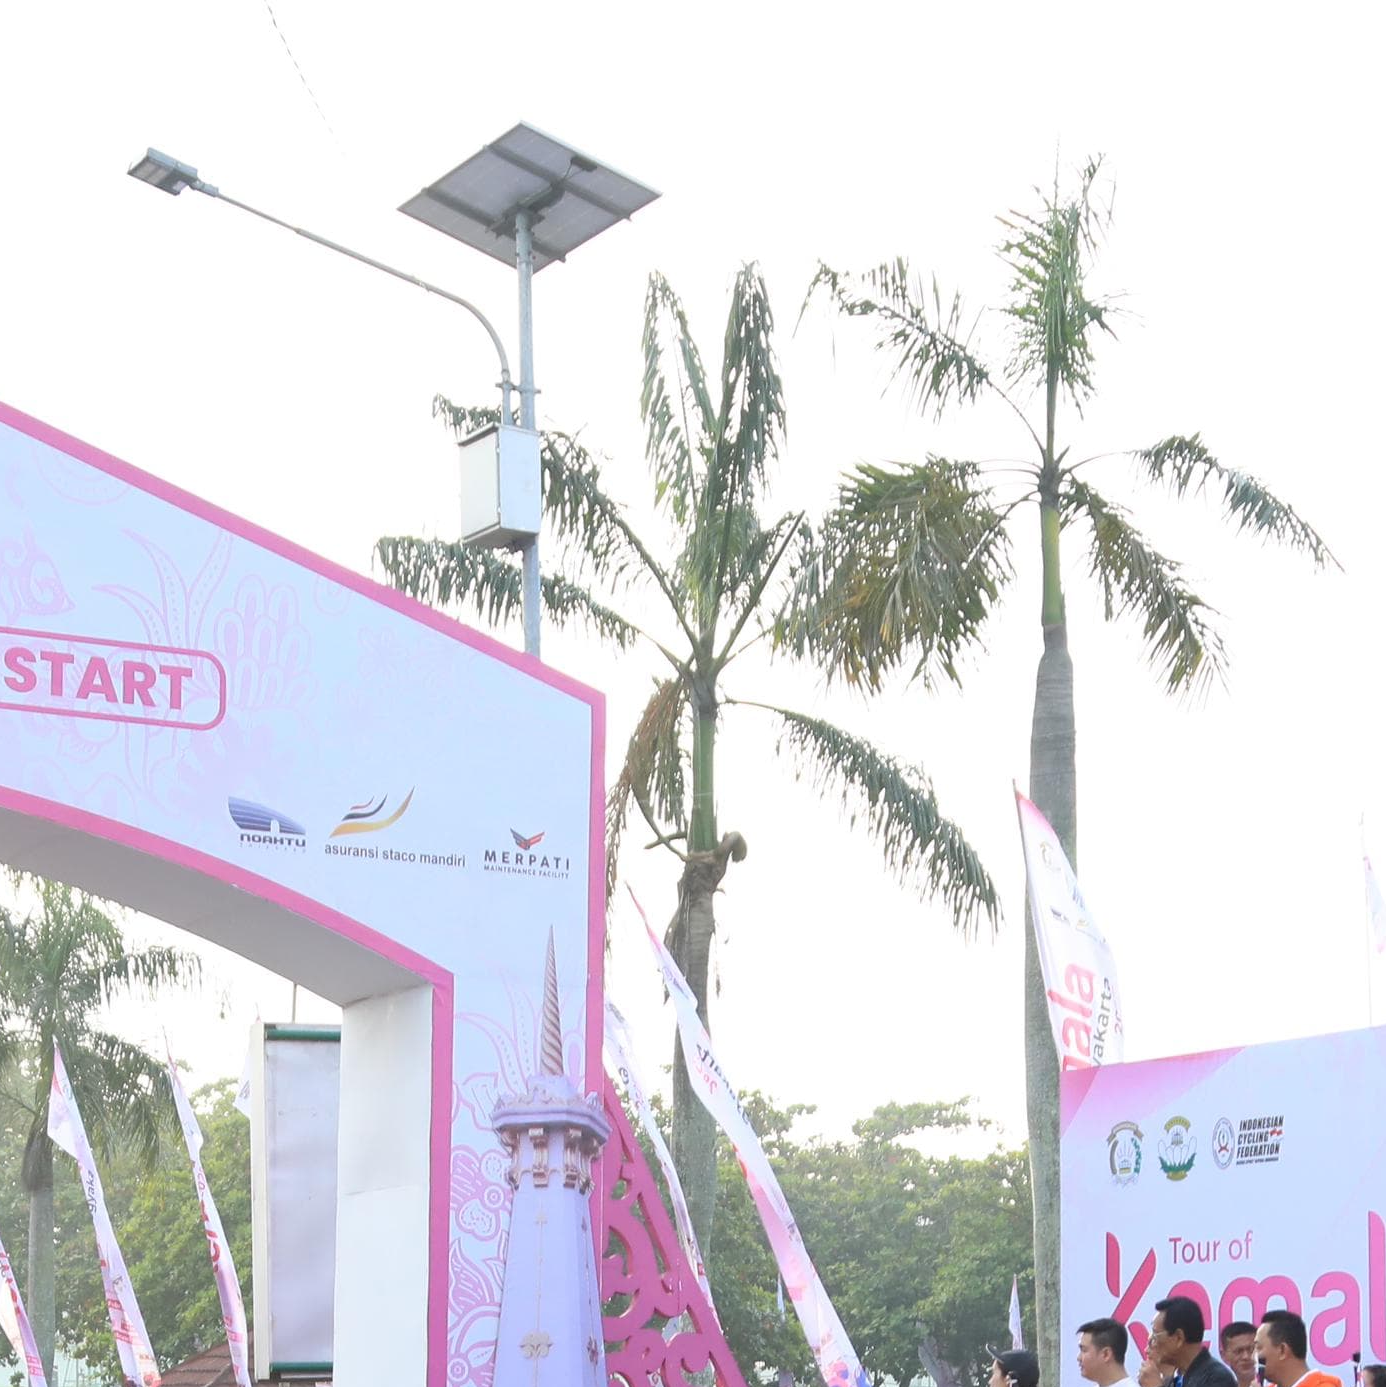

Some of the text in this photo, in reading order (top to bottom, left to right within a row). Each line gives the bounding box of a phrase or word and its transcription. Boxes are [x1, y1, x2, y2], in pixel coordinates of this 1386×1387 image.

[4, 646, 193, 710] START
[325, 844, 466, 867] asuransi staco mandiri
[484, 850, 570, 871] MERPATI
[1240, 1116, 1284, 1131] INDONESIAN
[1238, 1130, 1269, 1144] CYCLING
[1237, 1144, 1280, 1159] FEDERATION
[1169, 1230, 1253, 1264] Tour of
